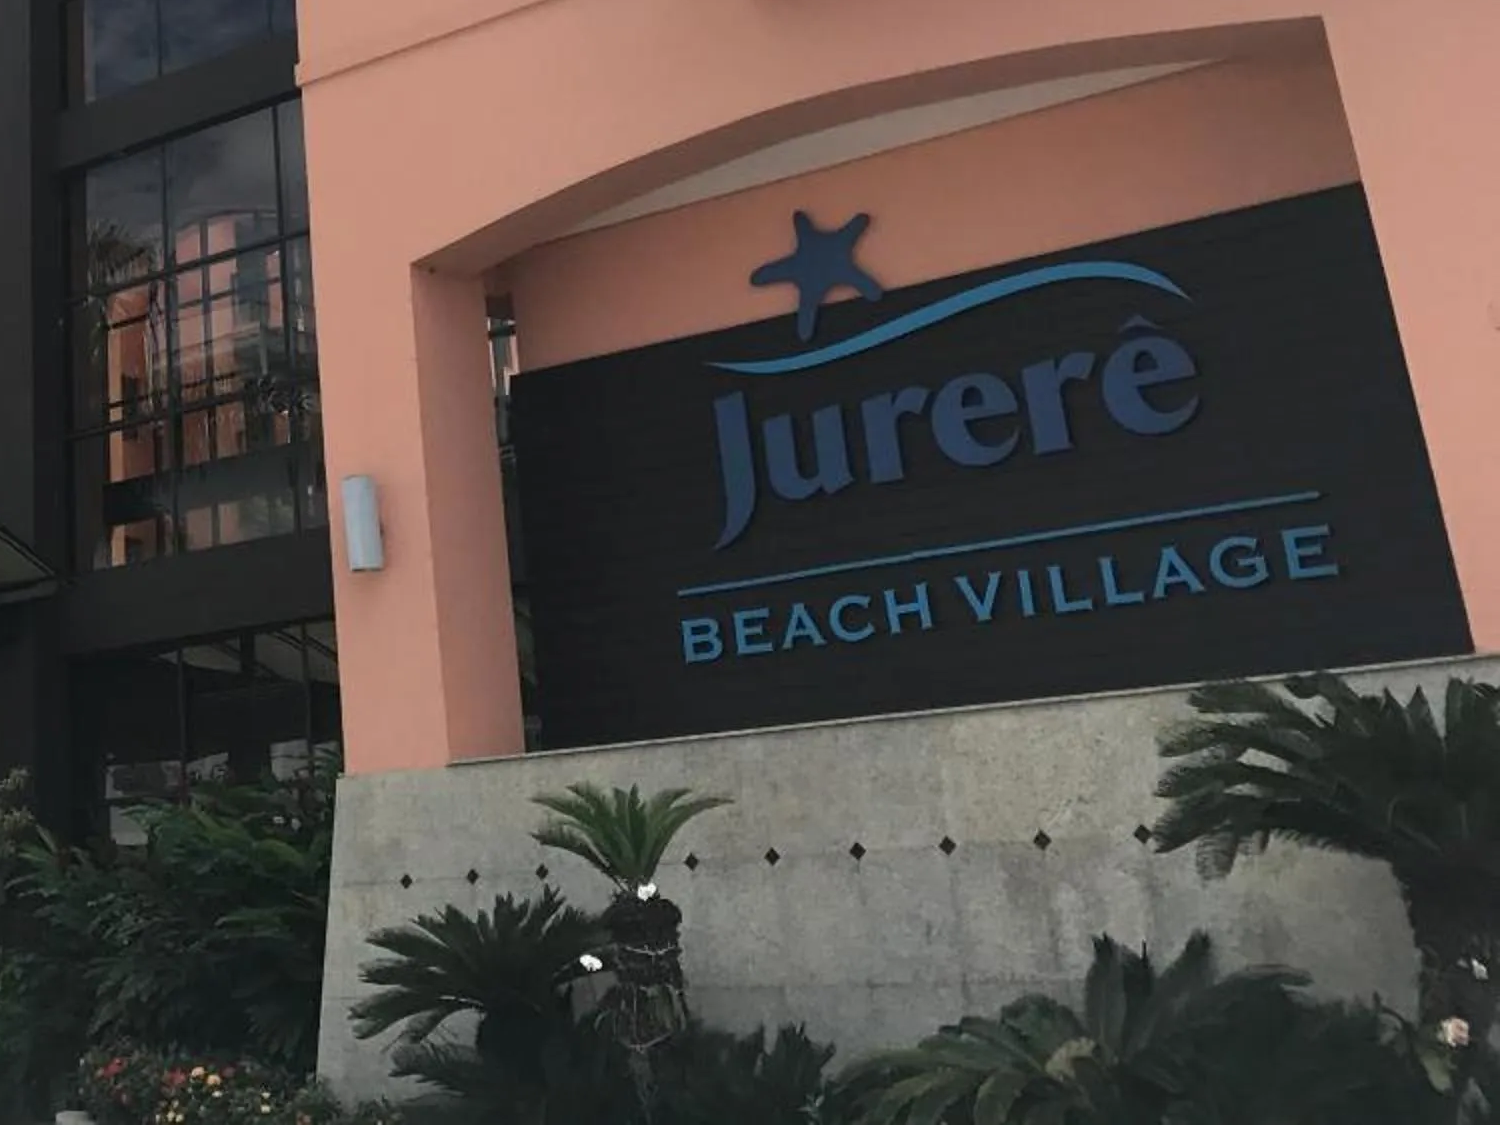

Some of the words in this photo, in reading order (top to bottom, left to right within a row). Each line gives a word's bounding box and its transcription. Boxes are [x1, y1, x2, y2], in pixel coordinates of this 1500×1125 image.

[712, 314, 1200, 550] Jurerê
[680, 583, 933, 664] BEACH
[955, 523, 1339, 623] VILLAGE
